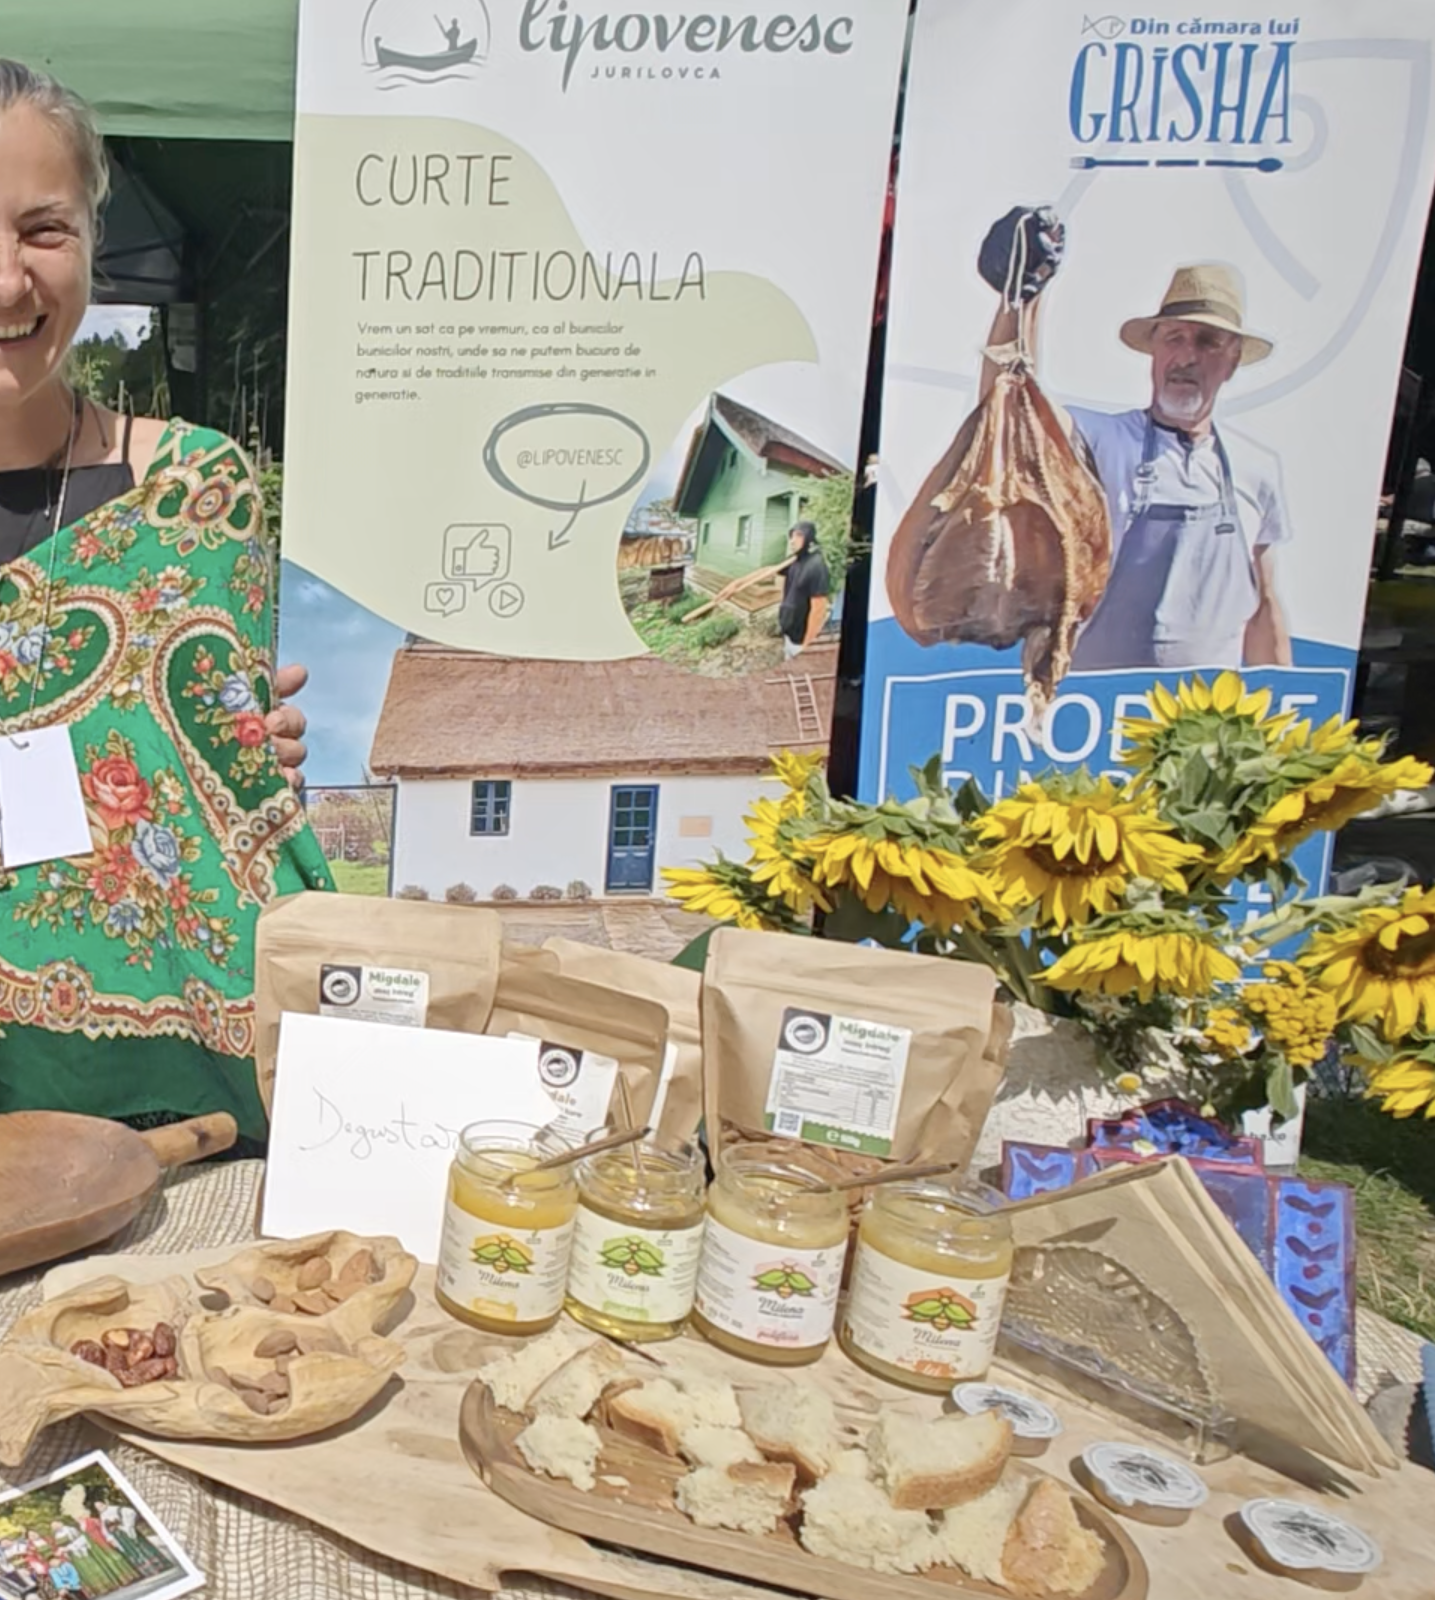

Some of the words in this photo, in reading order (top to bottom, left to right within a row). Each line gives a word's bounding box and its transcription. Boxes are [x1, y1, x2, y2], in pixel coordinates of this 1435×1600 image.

[1130, 17, 1170, 35] Din
[1175, 17, 1262, 35] cămara
[1268, 17, 1301, 36] lui
[518, 0, 853, 93] lipovenesc
[590, 65, 722, 79] JURILOVCA
[355, 153, 513, 207] CURTE
[352, 250, 706, 301] TRADITIONALA
[357, 322, 393, 335] Vrem
[396, 325, 412, 335] un
[415, 322, 435, 335] sat
[438, 325, 455, 335] ca
[458, 325, 475, 338] pe
[531, 325, 550, 335] ca
[553, 321, 566, 335] al
[569, 320, 625, 335] bunicilor
[356, 343, 413, 357] bunicilor
[415, 345, 454, 359] nostri,
[457, 344, 489, 357] unde
[491, 346, 508, 357] sa
[510, 346, 527, 357] ne
[529, 345, 573, 360] putem
[575, 343, 621, 357] bucura
[623, 342, 641, 357] de
[355, 367, 399, 379] natura
[401, 367, 412, 378] si
[415, 365, 433, 378] de
[435, 364, 488, 379] traditiile
[490, 367, 553, 379] transmise
[555, 364, 577, 378] din
[579, 367, 642, 382] generatie
[645, 366, 657, 378] in
[354, 389, 422, 404] generatie.
[516, 448, 624, 470] @LIPOVENESC
